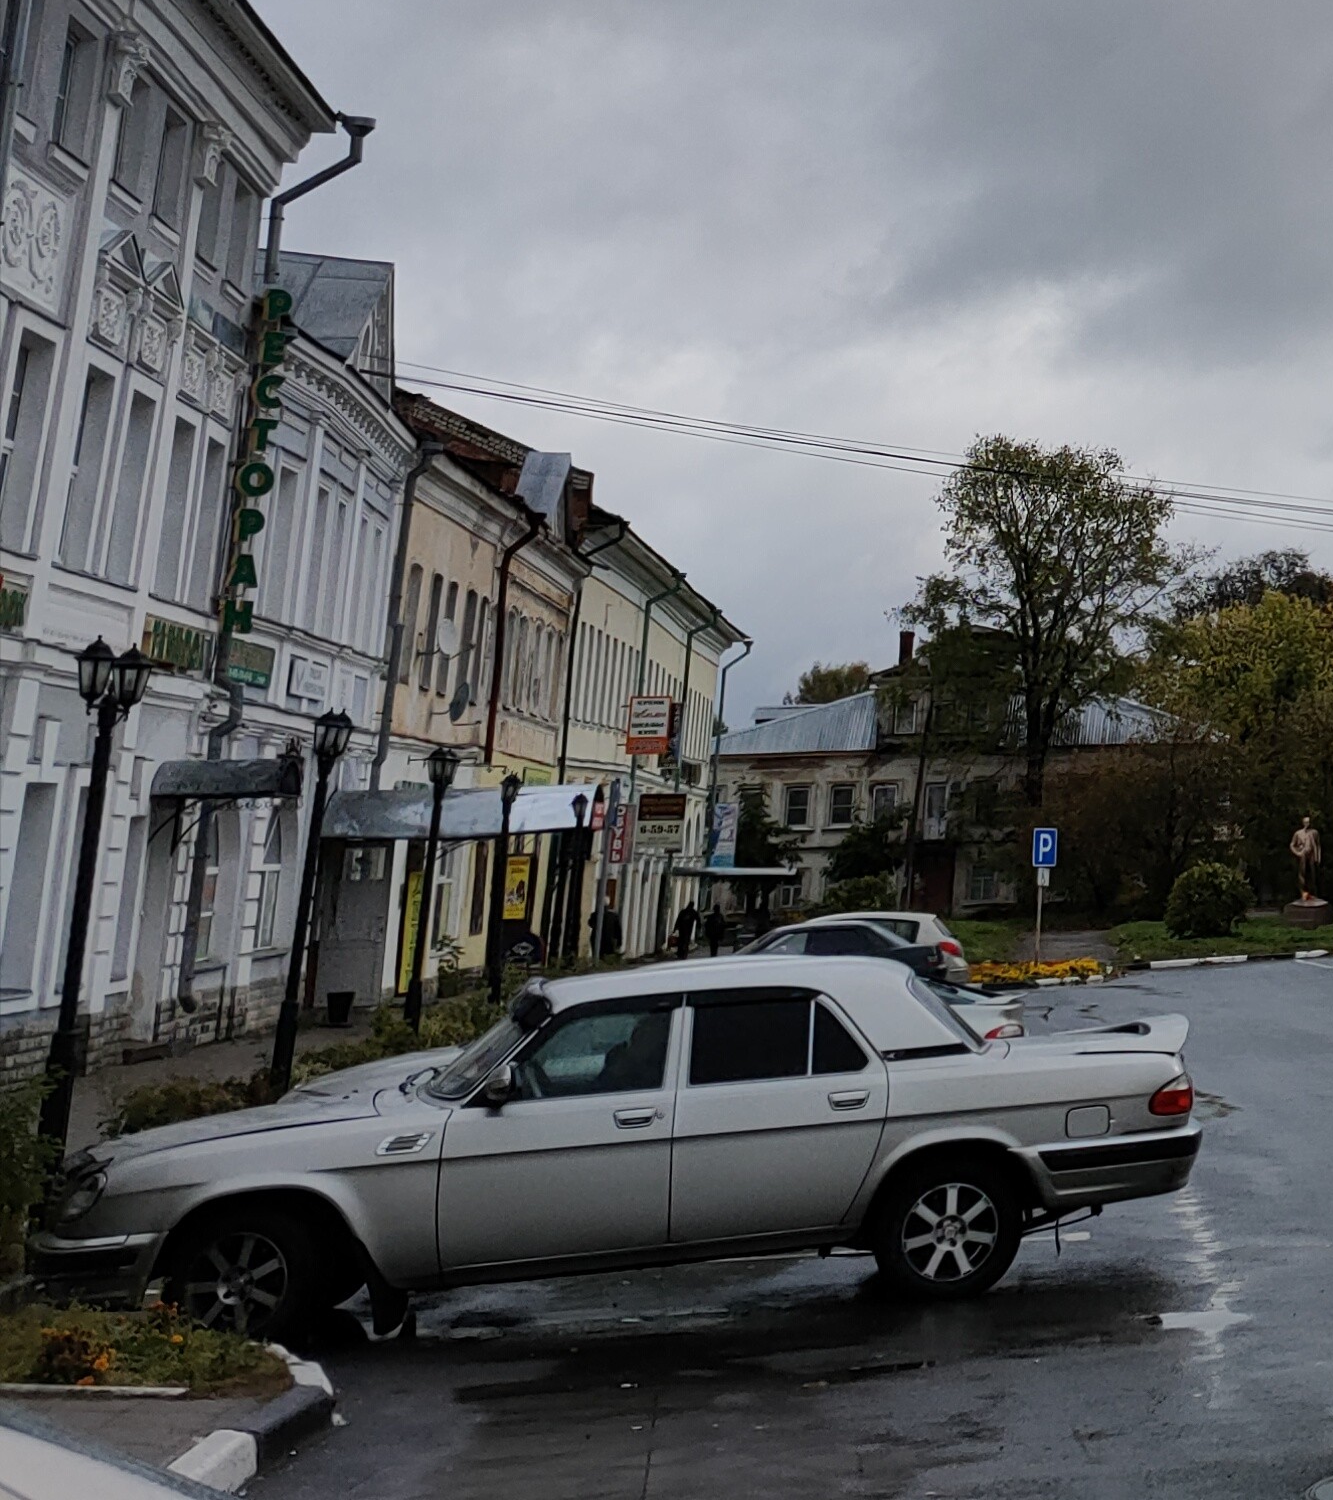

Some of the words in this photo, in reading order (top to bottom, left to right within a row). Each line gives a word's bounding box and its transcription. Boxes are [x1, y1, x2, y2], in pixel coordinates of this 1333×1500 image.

[221, 288, 293, 635] РЕСТОРАН
[640, 824, 680, 834] 6-59-57
[1039, 832, 1053, 863] P
